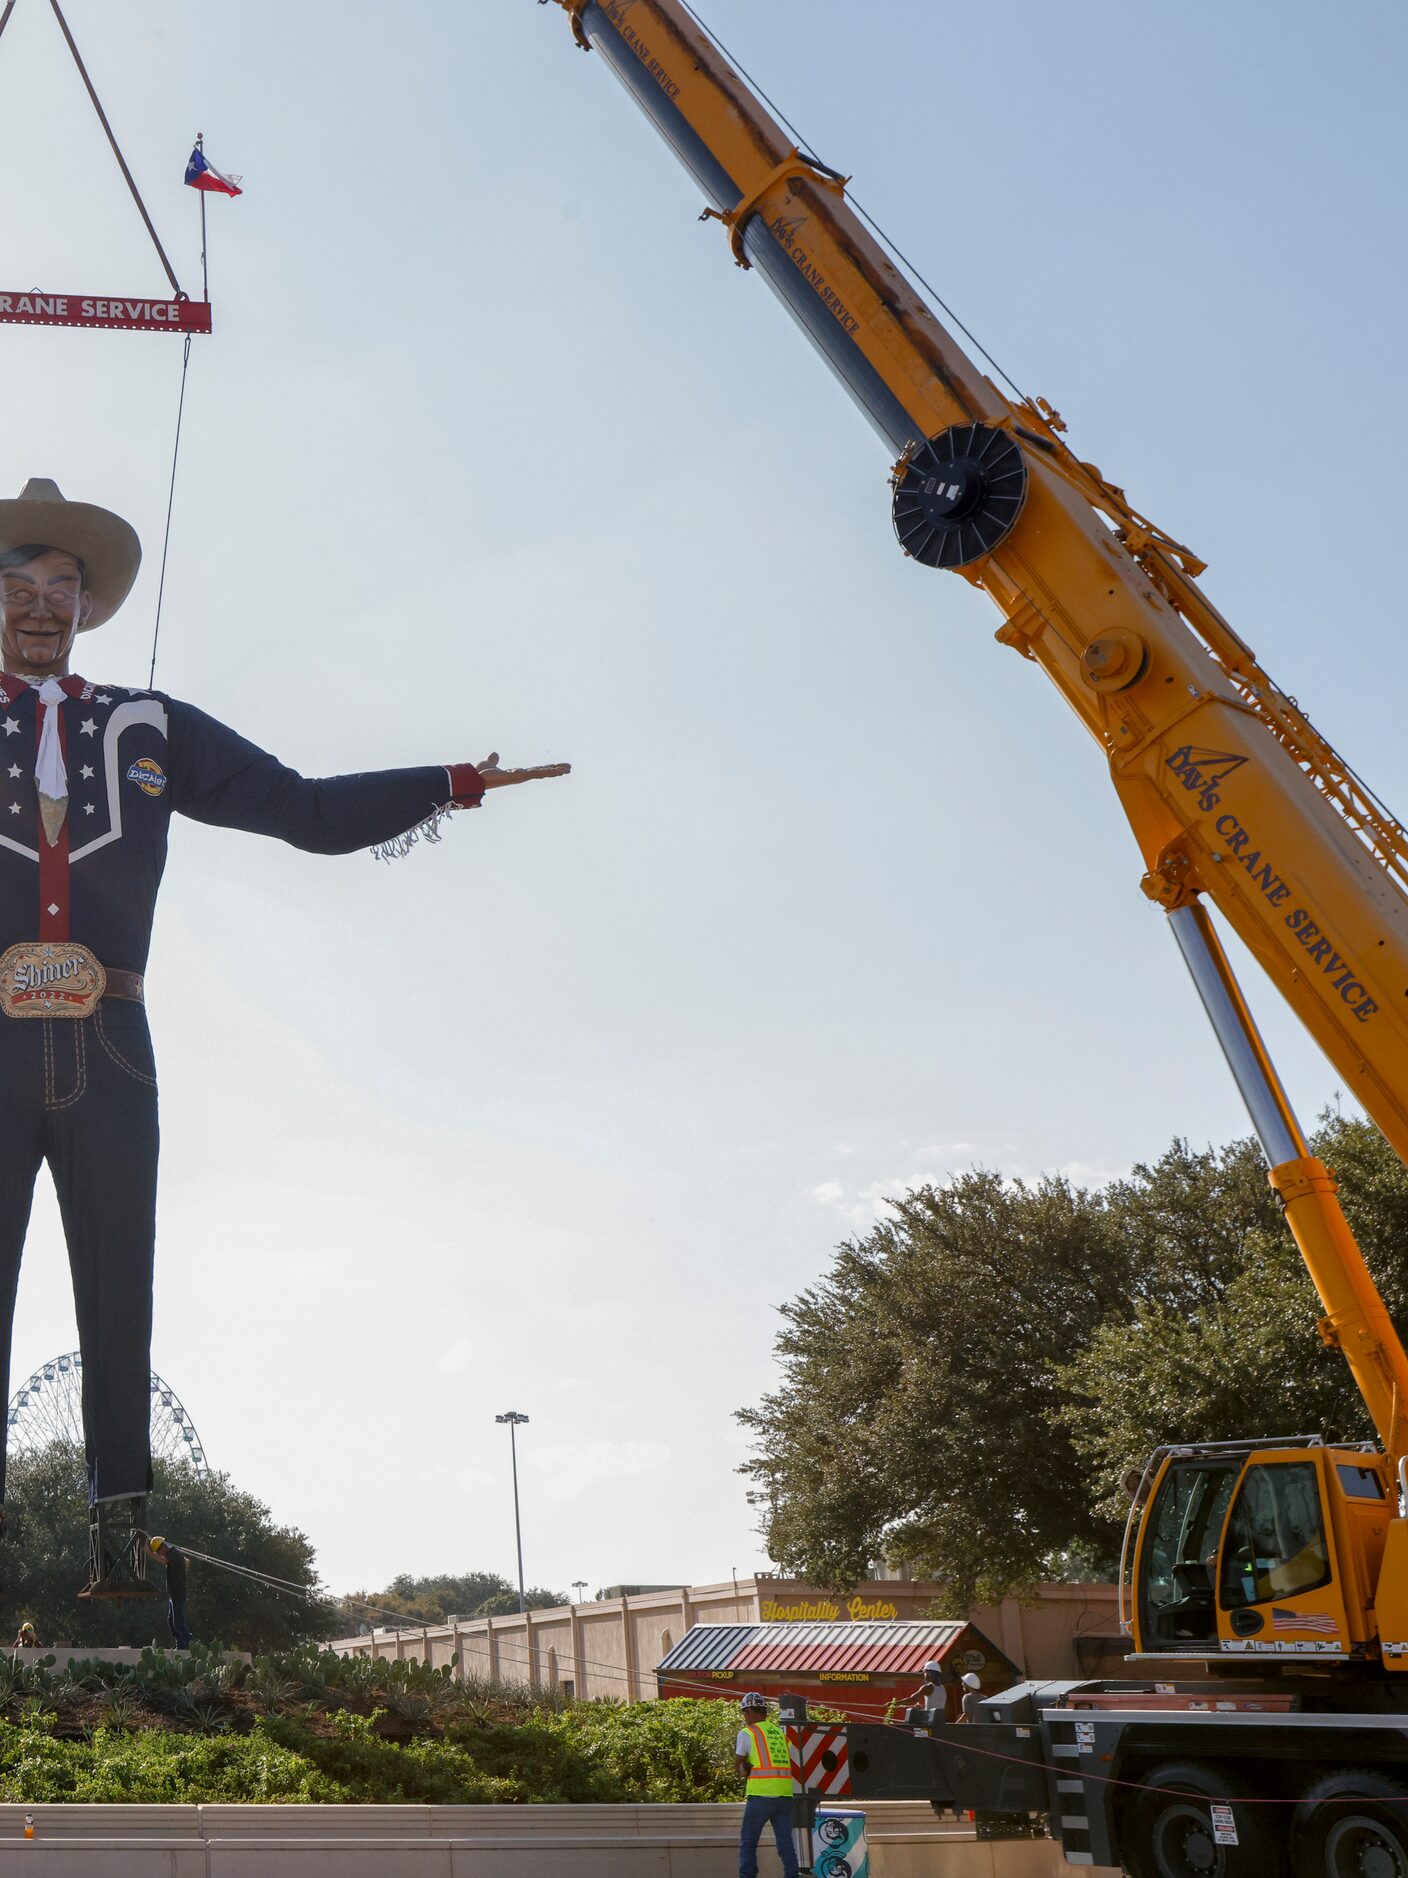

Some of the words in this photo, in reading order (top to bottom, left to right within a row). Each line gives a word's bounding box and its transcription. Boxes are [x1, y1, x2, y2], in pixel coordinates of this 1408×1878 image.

[647, 58, 681, 100] SERVICE
[792, 247, 825, 289] CRANE
[820, 286, 860, 336] SERVICE
[81, 300, 180, 322] SERVICE
[1165, 746, 1221, 812] DAVIS
[1215, 814, 1291, 908] CRANE
[1285, 908, 1379, 1023] SERVICE
[12, 957, 86, 992] Shiner
[30, 991, 65, 1000] 2022
[761, 1600, 841, 1621] Hospitality
[846, 1596, 898, 1621] Center
[711, 1671, 735, 1680] PICKUP
[819, 1672, 869, 1681] INFORMATION
